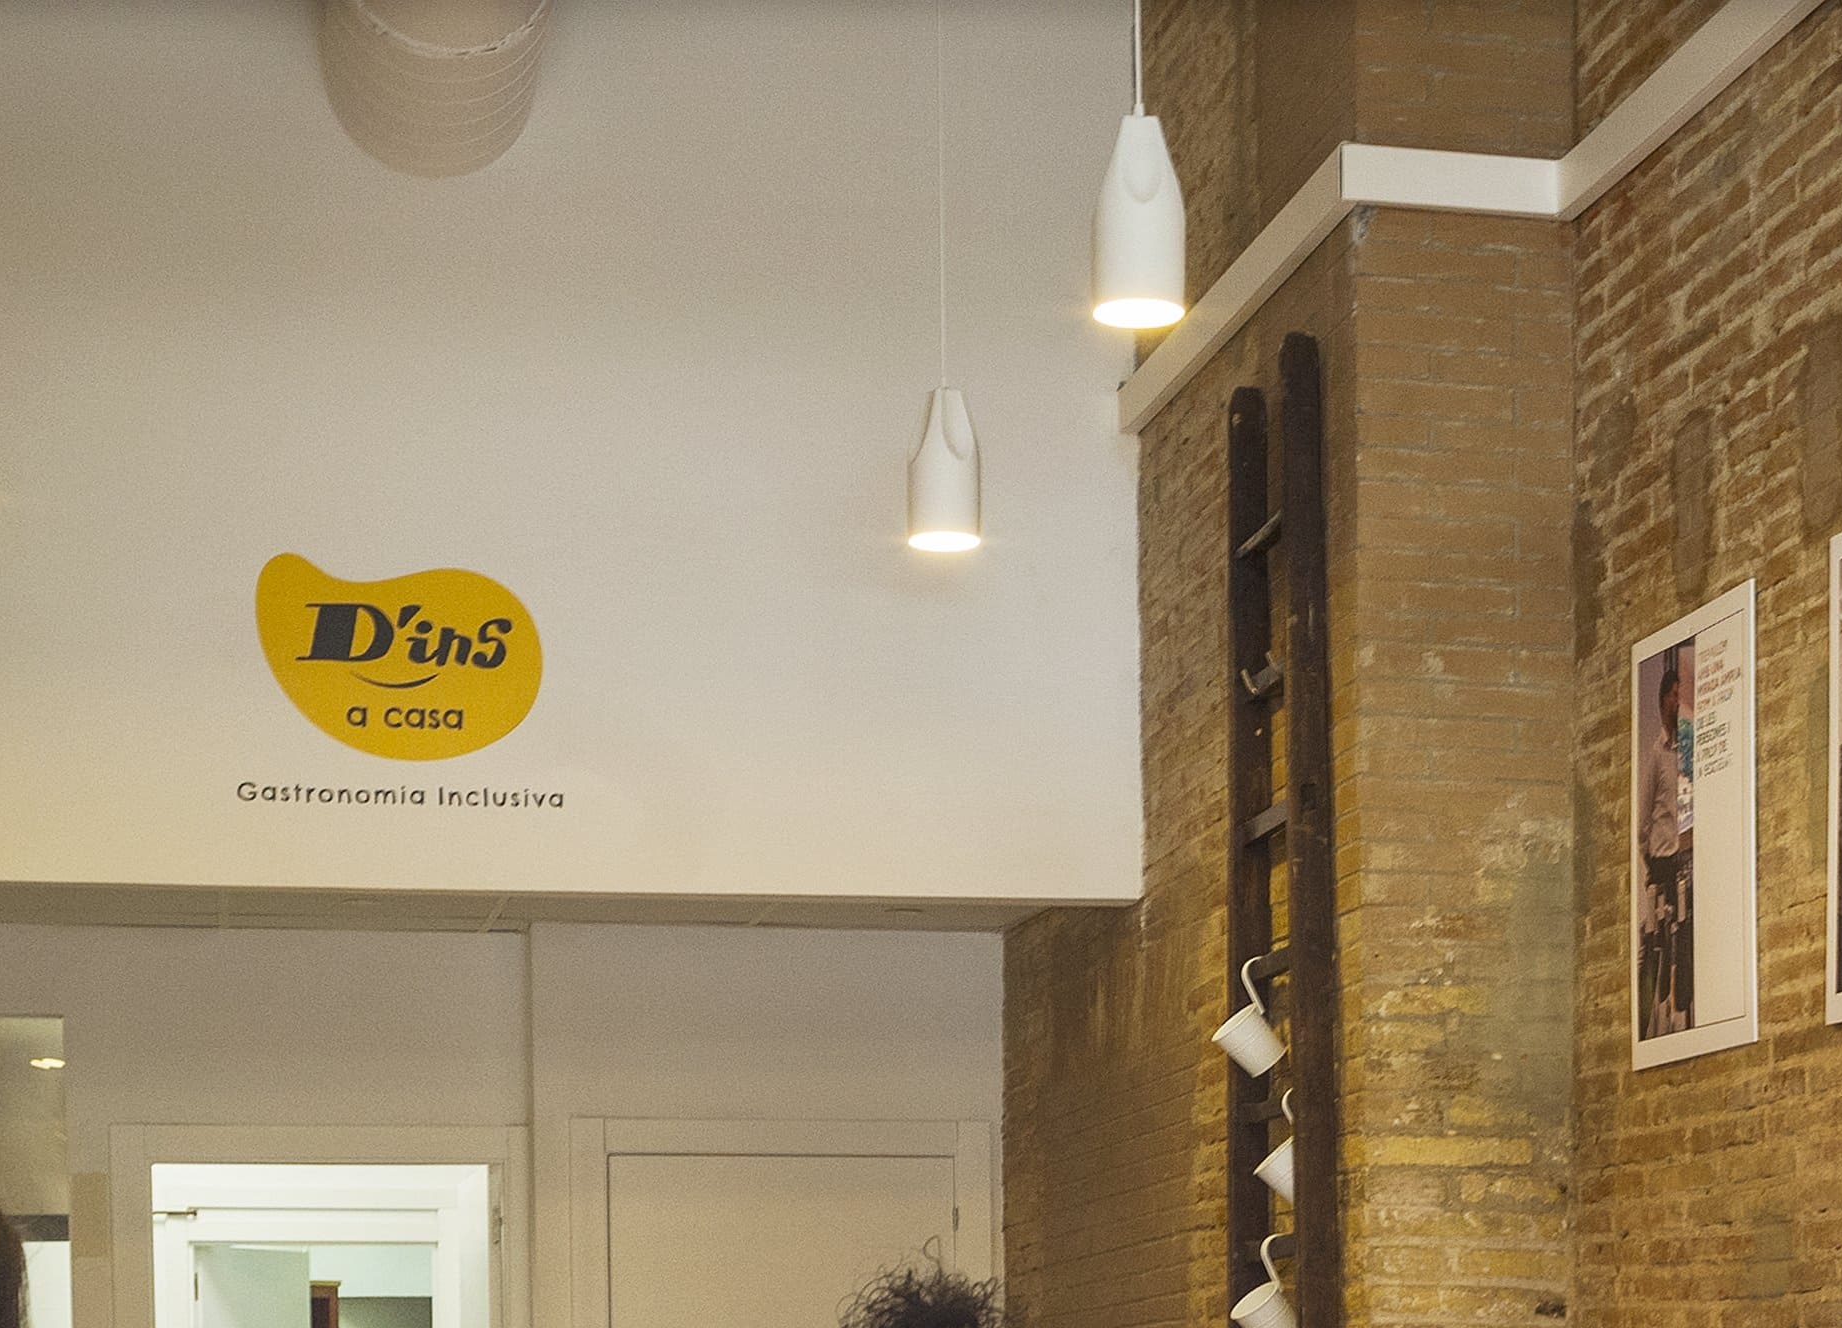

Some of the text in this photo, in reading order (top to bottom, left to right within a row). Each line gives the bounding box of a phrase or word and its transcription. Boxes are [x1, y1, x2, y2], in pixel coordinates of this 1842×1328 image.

[296, 602, 513, 669] D'ins
[346, 706, 464, 730] a casa
[439, 787, 564, 808] Inclusiva
